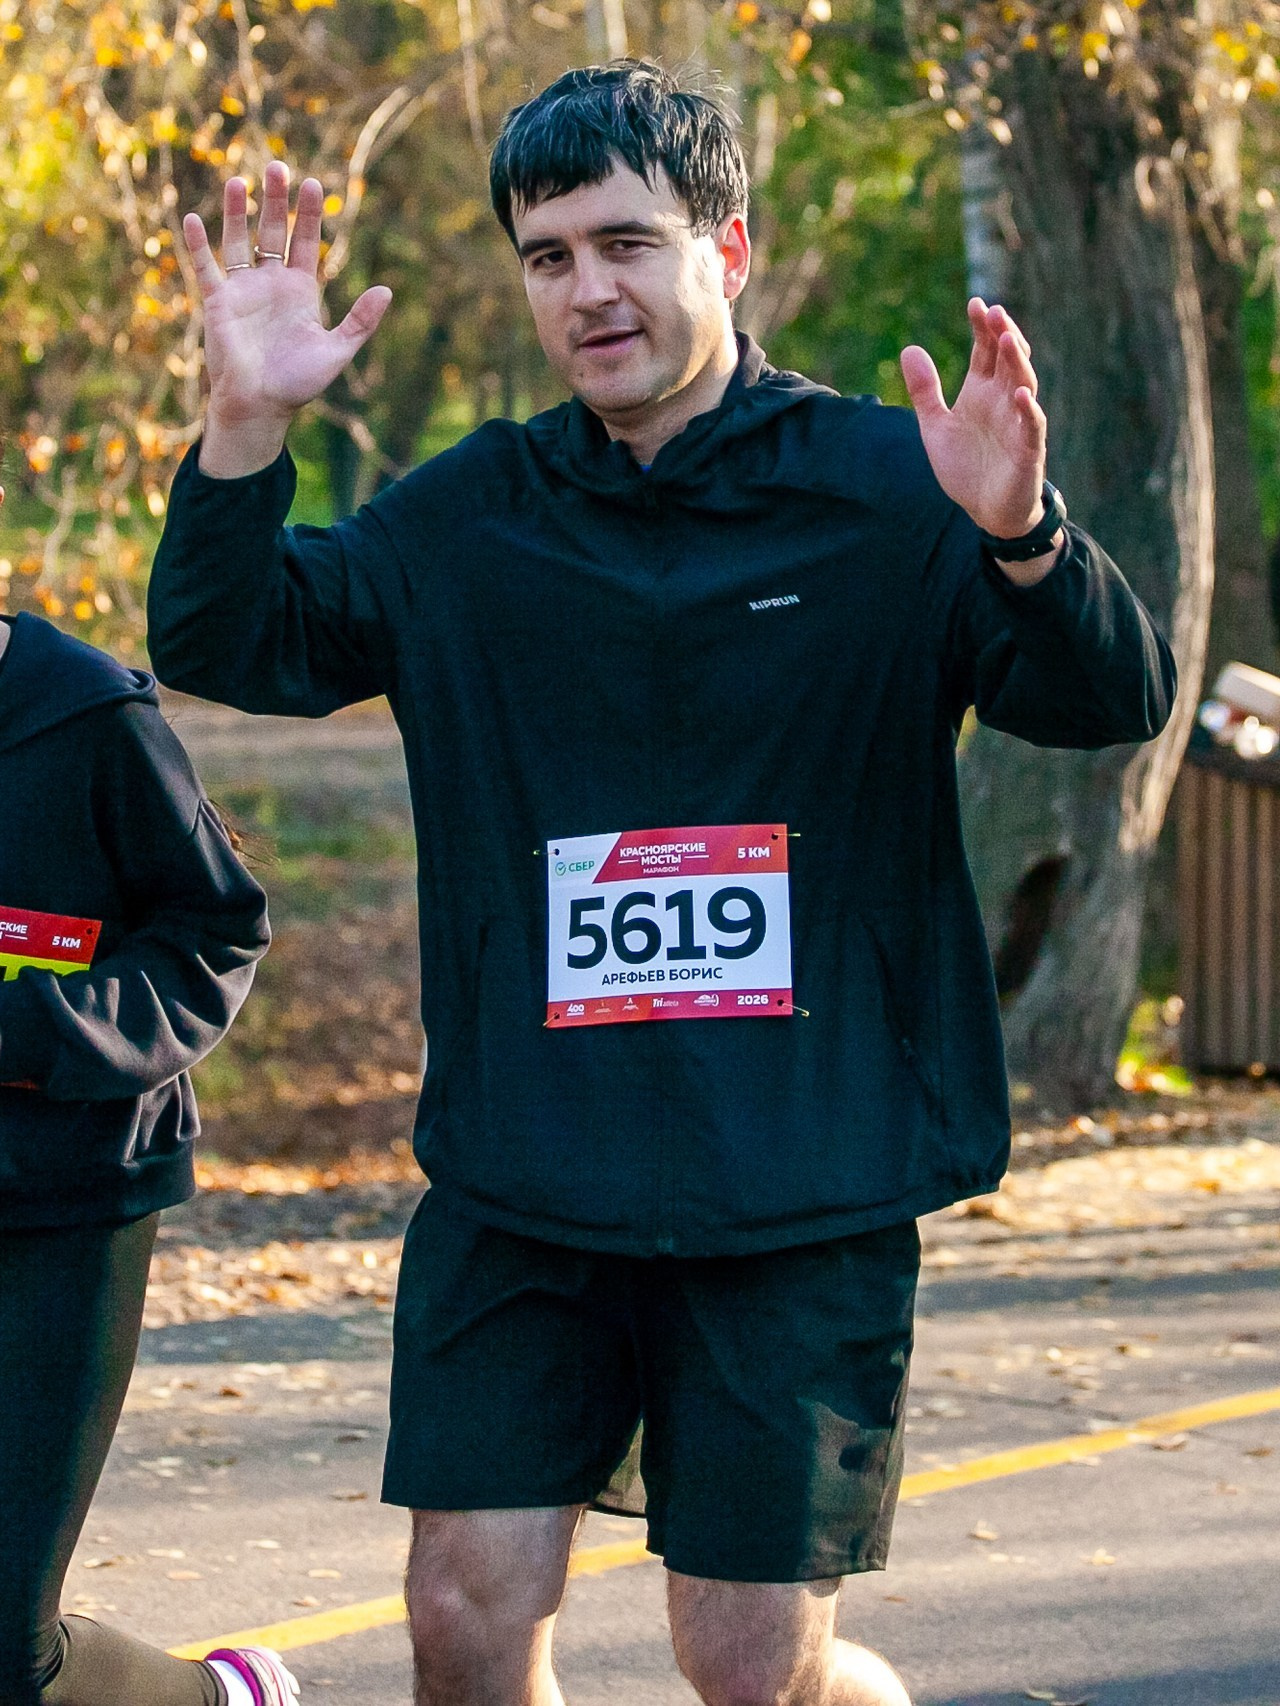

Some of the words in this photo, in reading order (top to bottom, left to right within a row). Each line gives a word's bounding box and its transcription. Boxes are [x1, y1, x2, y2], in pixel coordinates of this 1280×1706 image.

[749, 594, 800, 611] KIPRUN
[619, 842, 706, 858] КРАСНОЯРСКИЕ
[737, 847, 747, 859] 5
[569, 860, 595, 872] СБЕР
[640, 854, 682, 866] МОСТЫ
[642, 865, 680, 874] МАРАФОН
[567, 886, 767, 970] 5619
[51, 935, 61, 948] 5
[601, 968, 666, 986] АРЕФЬЕВ
[668, 967, 723, 981] БОРИС
[737, 994, 769, 1006] 2026
